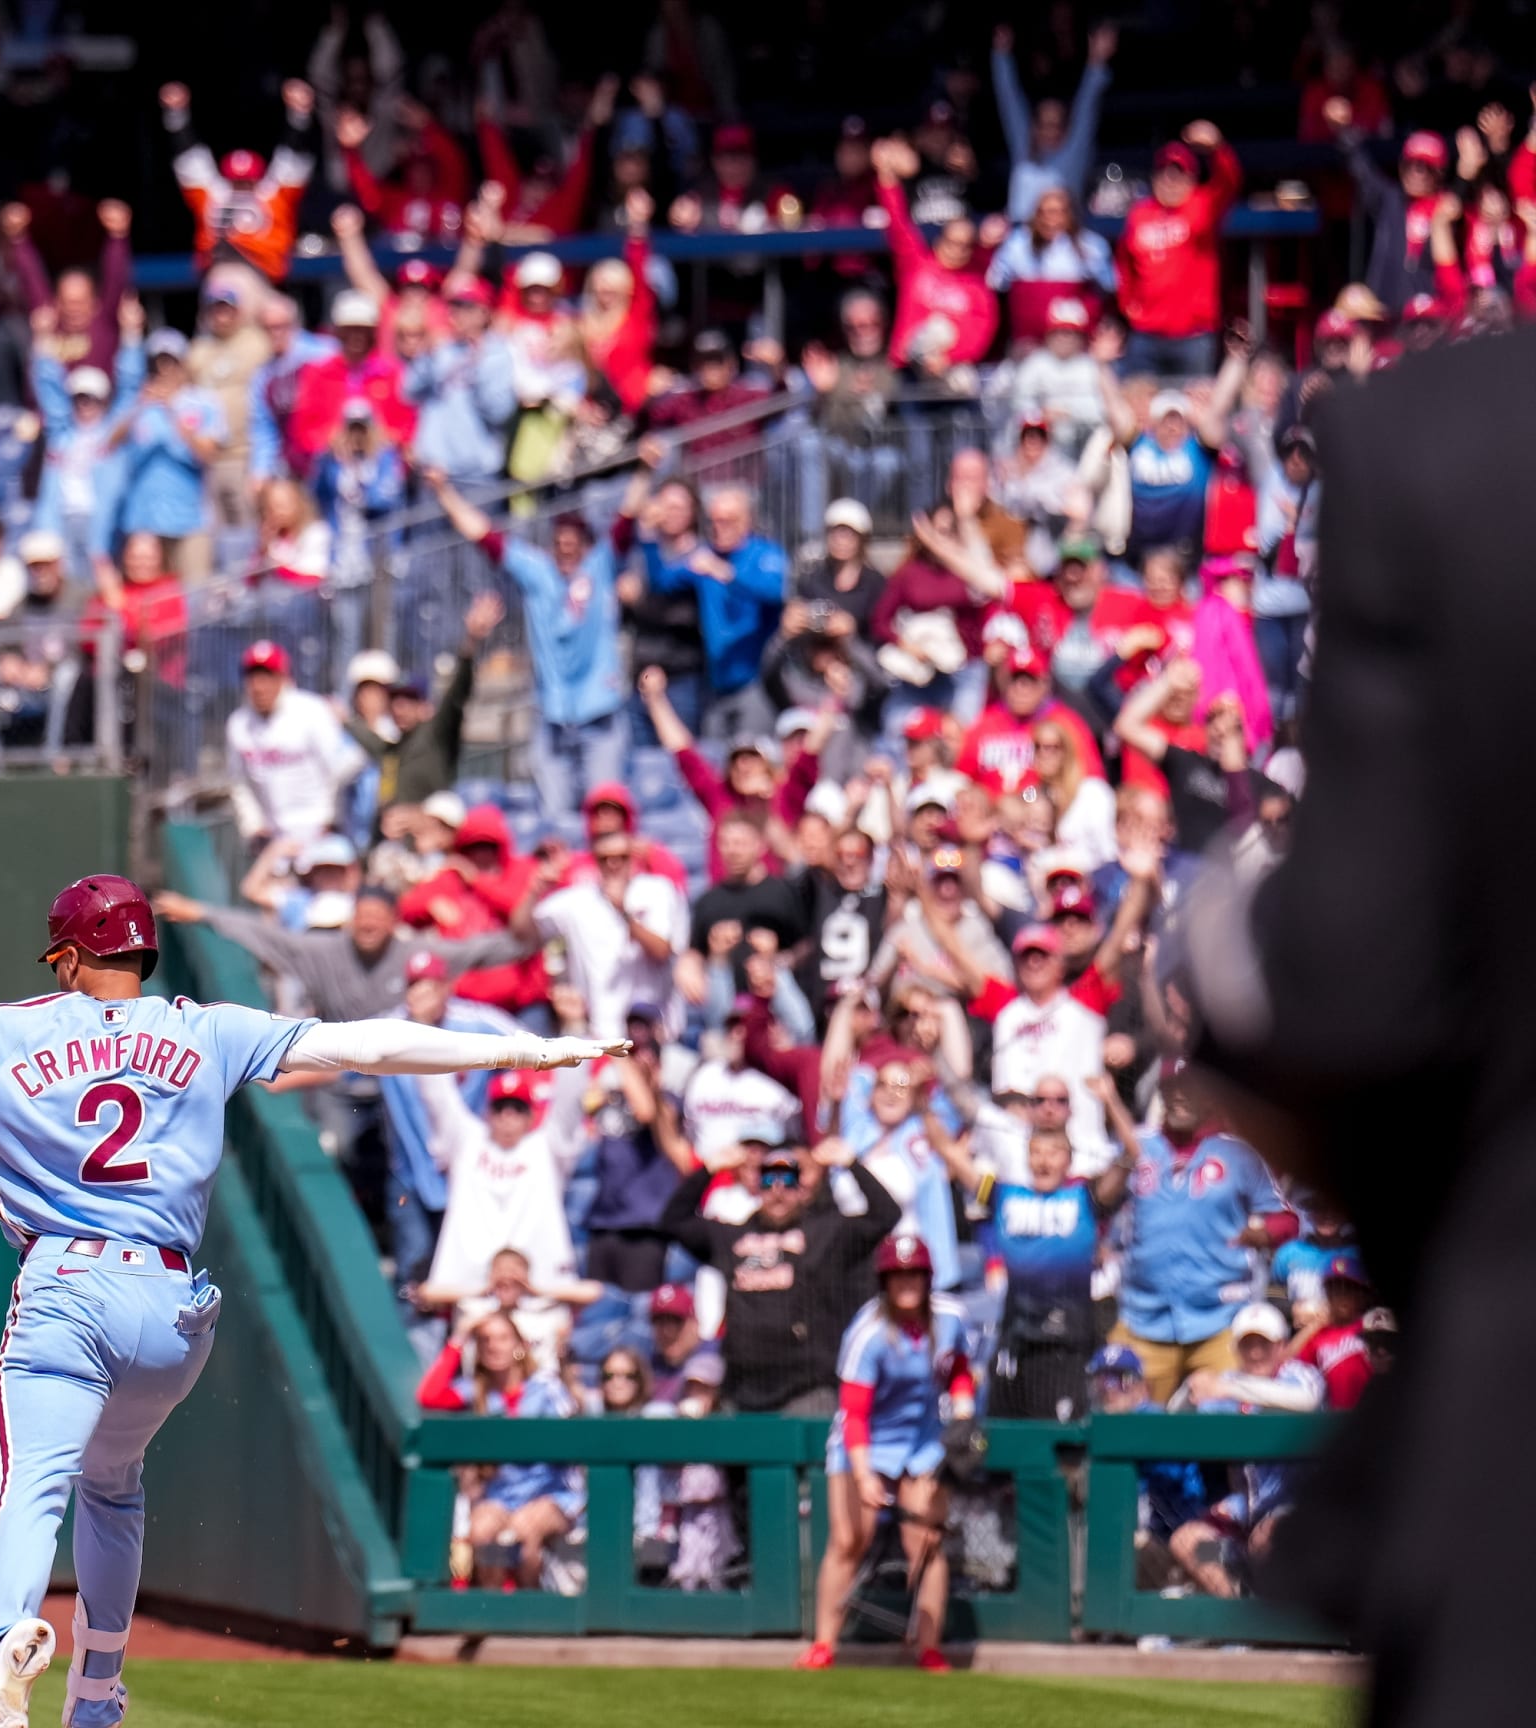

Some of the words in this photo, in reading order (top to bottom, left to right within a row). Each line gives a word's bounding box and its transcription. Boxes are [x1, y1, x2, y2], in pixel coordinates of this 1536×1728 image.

[128, 920, 139, 936] 2
[820, 911, 871, 982] 9
[10, 1031, 203, 1099] CRAWFORD
[74, 1080, 153, 1187] 2
